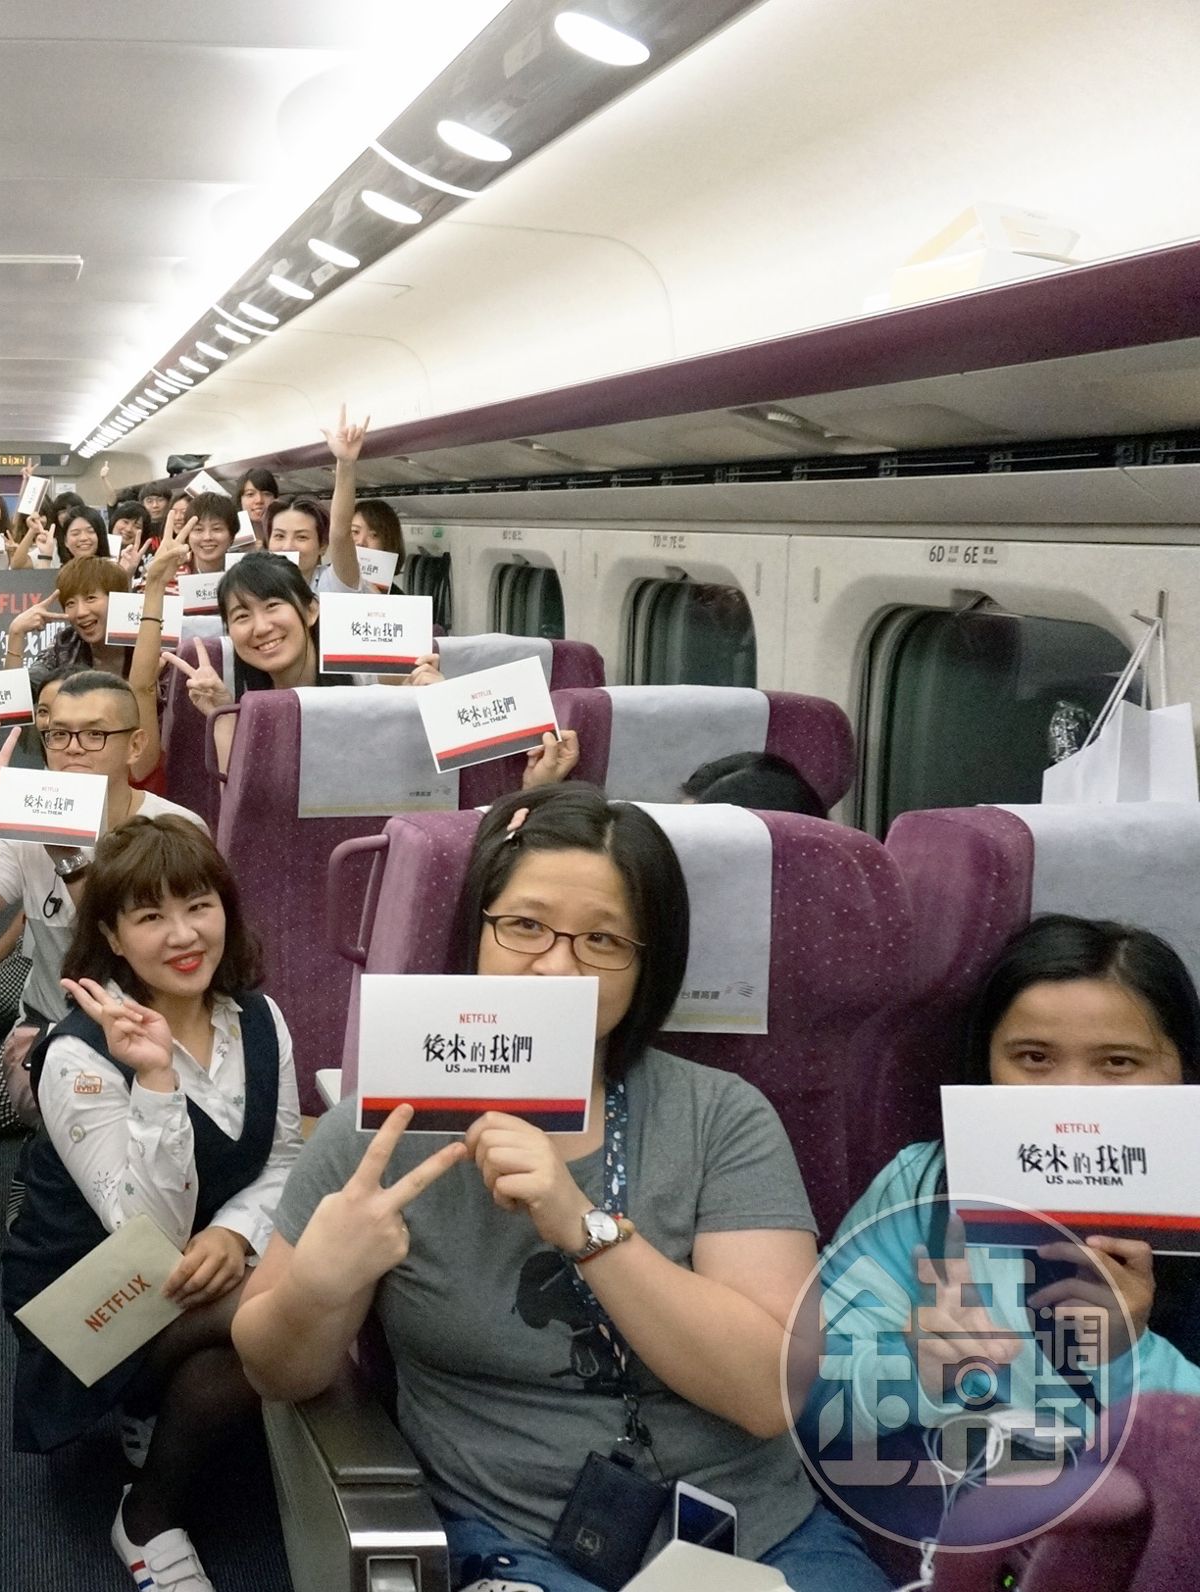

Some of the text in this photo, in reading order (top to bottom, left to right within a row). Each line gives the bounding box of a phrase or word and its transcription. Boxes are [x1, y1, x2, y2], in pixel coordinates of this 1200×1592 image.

[929, 545, 945, 562] 6D
[964, 546, 979, 563] 6E
[459, 1013, 498, 1025] NETFLIX
[423, 1033, 533, 1063] 後來的我們
[445, 1064, 460, 1073] US
[478, 1064, 510, 1074] THEM
[1055, 1123, 1101, 1135] NETFLIX
[1017, 1143, 1148, 1175] 後來的我們
[1045, 1176, 1064, 1185] US
[1084, 1176, 1124, 1186] THEM
[85, 1274, 151, 1333] NETFLIX
